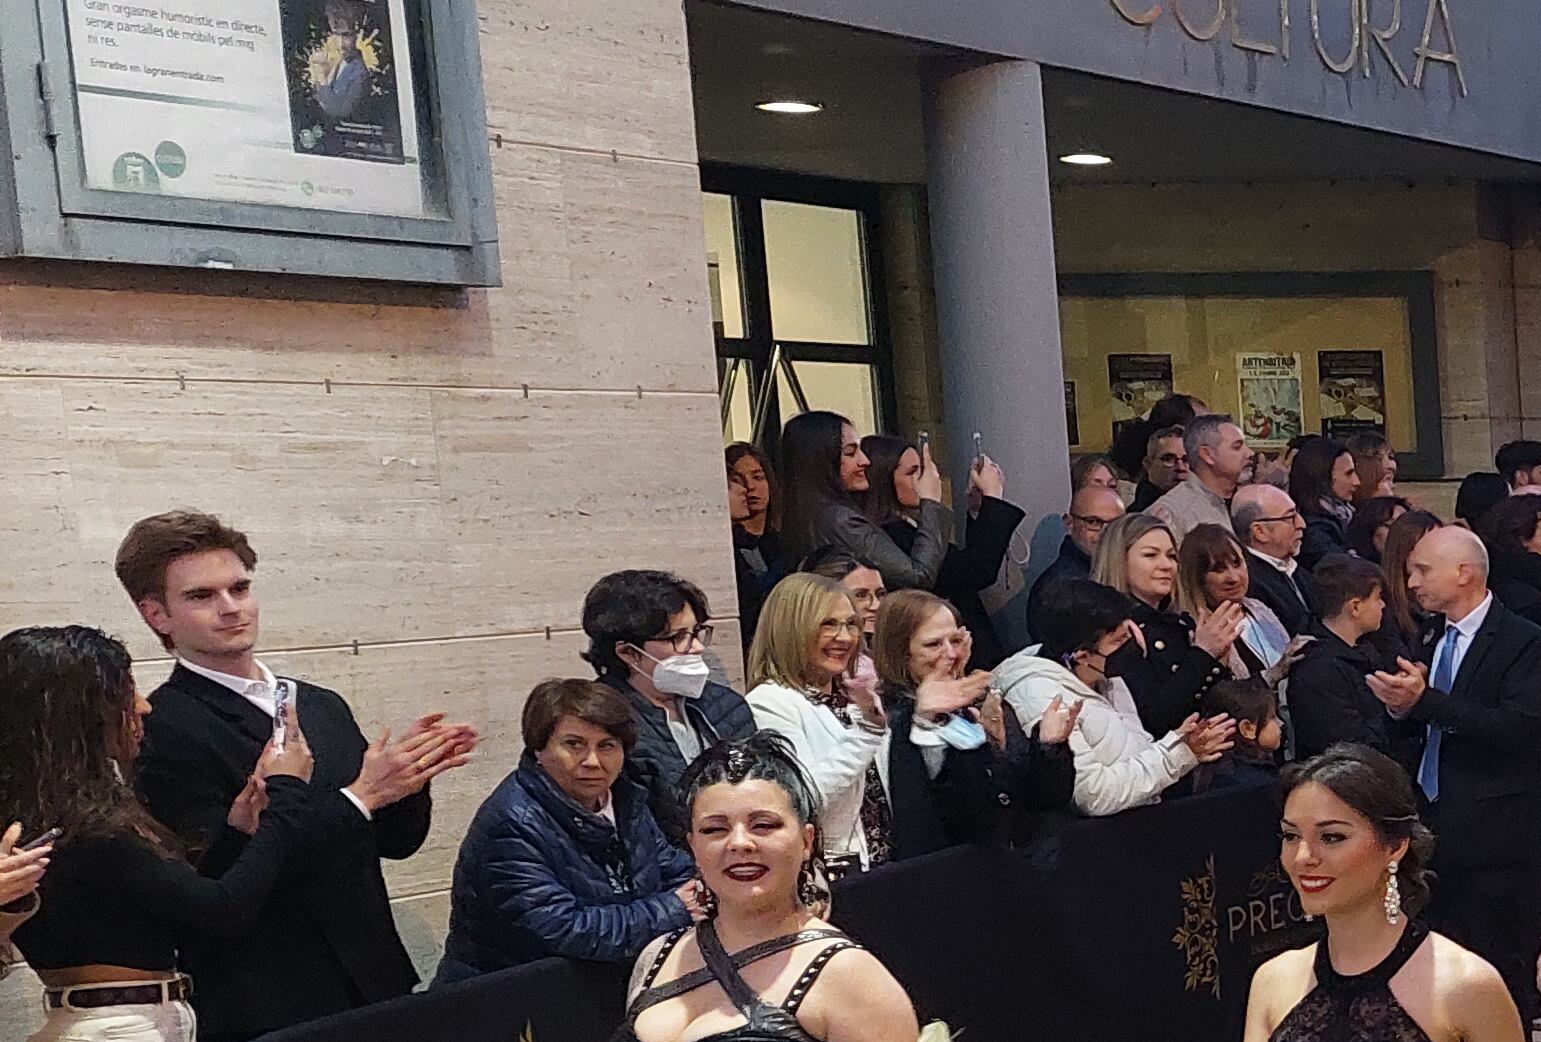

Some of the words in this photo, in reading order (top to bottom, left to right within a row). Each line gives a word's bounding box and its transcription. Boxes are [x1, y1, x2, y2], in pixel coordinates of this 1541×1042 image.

[112, 4, 159, 19] orgasme
[215, 20, 230, 30] en
[165, 26, 181, 39] de
